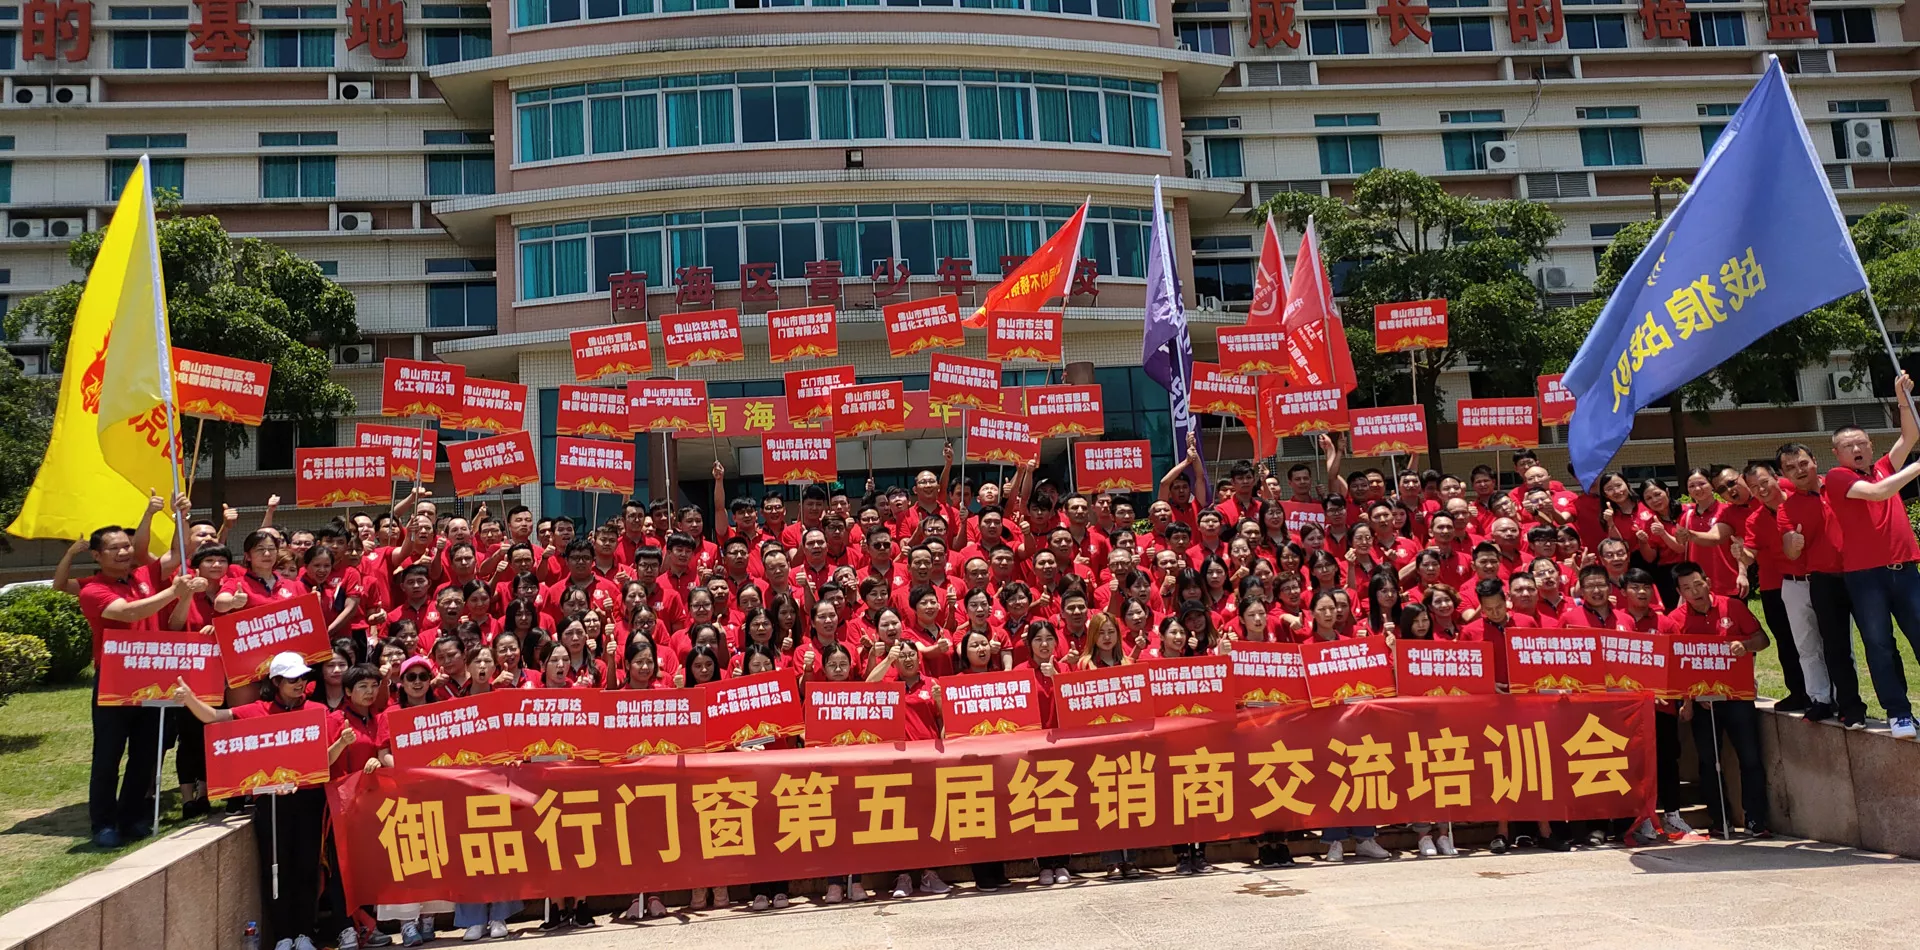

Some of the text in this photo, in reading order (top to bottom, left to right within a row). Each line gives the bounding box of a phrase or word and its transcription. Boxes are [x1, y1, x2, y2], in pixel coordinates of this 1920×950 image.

[777, 323, 829, 339] 门窗有限公司
[400, 367, 451, 383] 佛山市江河
[394, 381, 455, 396] 化工有限公司
[840, 399, 895, 414] 食品有限公司
[361, 444, 433, 461] 有限公司
[771, 449, 828, 462] 材料有限公司
[460, 450, 525, 473] 制衣有限公司
[302, 467, 386, 480] 电子股份有限公司
[235, 605, 304, 637] 佛山市明州
[233, 619, 314, 653] 机械有限公司
[1673, 641, 1737, 657] 佛山市禅城
[123, 656, 205, 670] 科技有限公司
[1519, 650, 1592, 666] 设备有限公司
[1602, 649, 1665, 668] 务有限公司
[1408, 662, 1484, 678] 电器有限公司
[1060, 673, 1146, 698] 佛山正能量节能
[1150, 679, 1223, 697] 科技有限公司
[520, 698, 582, 712] 广东万事达
[707, 690, 793, 718] 技术股份有限公司
[811, 690, 900, 705] 佛山市威尔普斯
[954, 694, 1028, 715] 门窗有限公司
[1068, 689, 1142, 711] 科技有限公司
[603, 711, 702, 729] 建筑机械有限公司
[817, 705, 894, 720] 门窗有限公司
[395, 715, 500, 749] 家居科技有限公司
[376, 713, 1632, 883] 御品行门窗第五届经销商交流培训会
